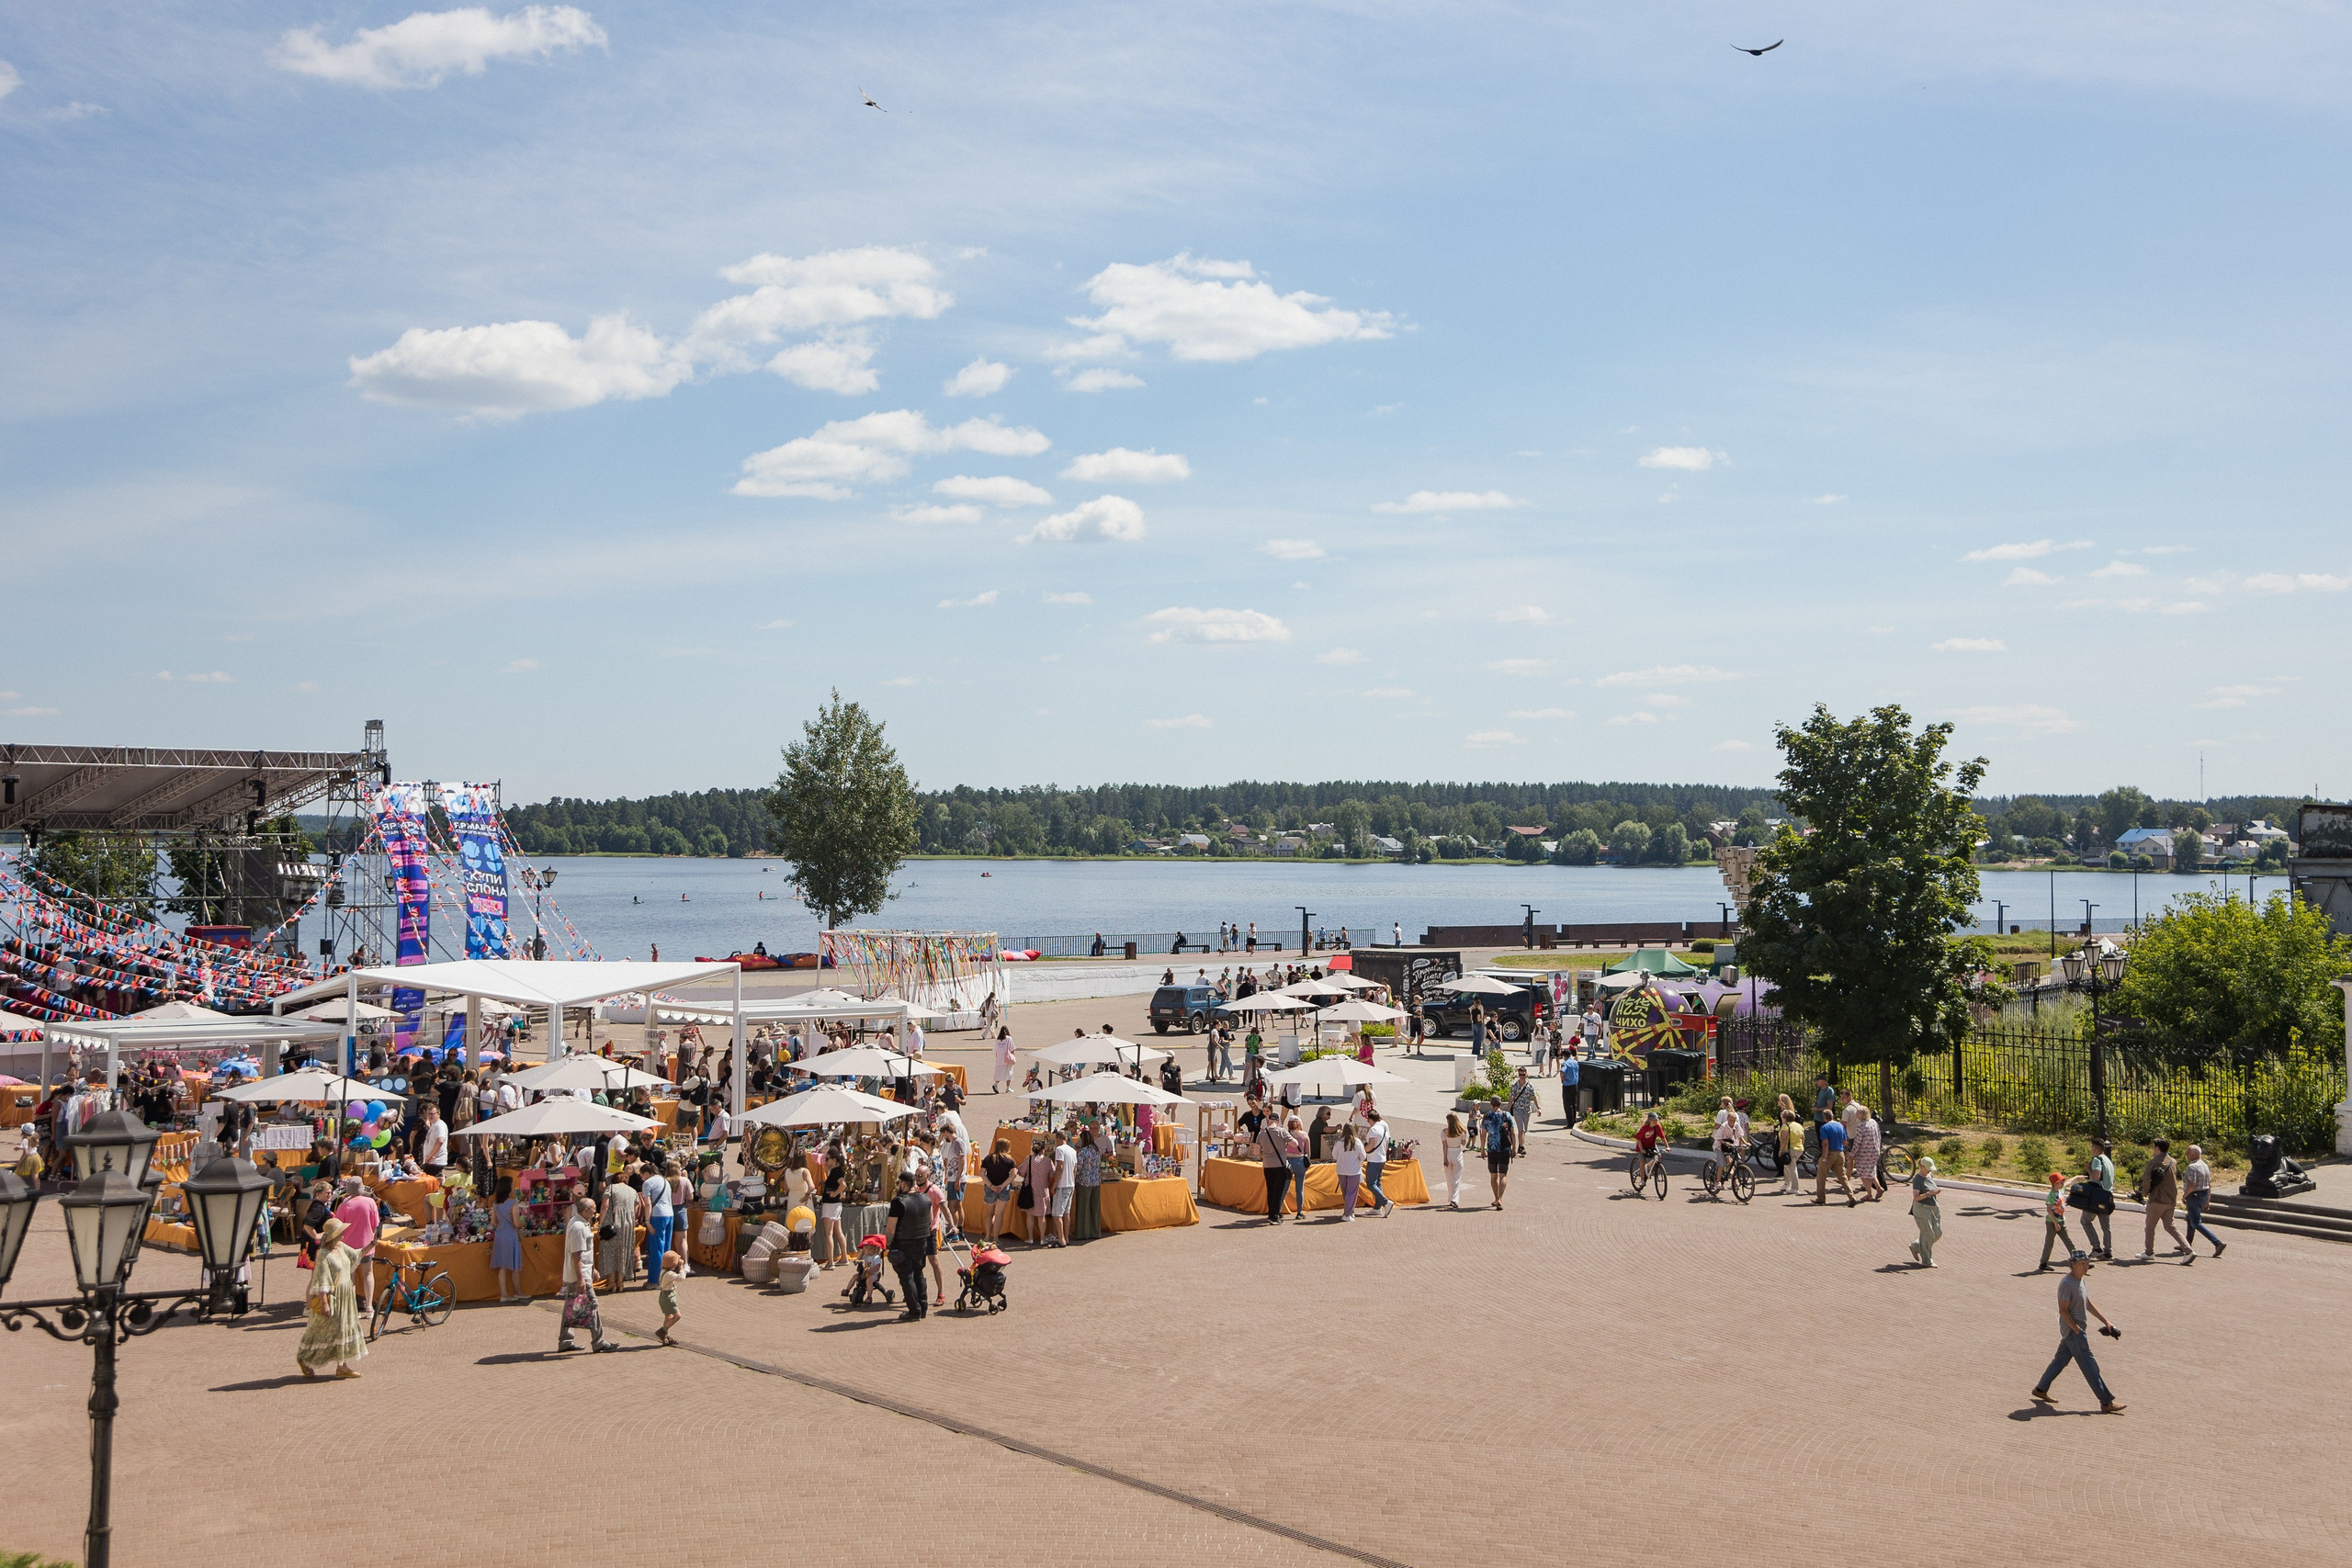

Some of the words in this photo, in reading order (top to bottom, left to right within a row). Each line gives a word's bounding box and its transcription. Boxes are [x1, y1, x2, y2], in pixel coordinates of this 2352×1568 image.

[470, 871, 503, 885] КУПИ
[467, 882, 508, 897] СЛОНА
[1615, 1017, 1646, 1028] ЧИХО
